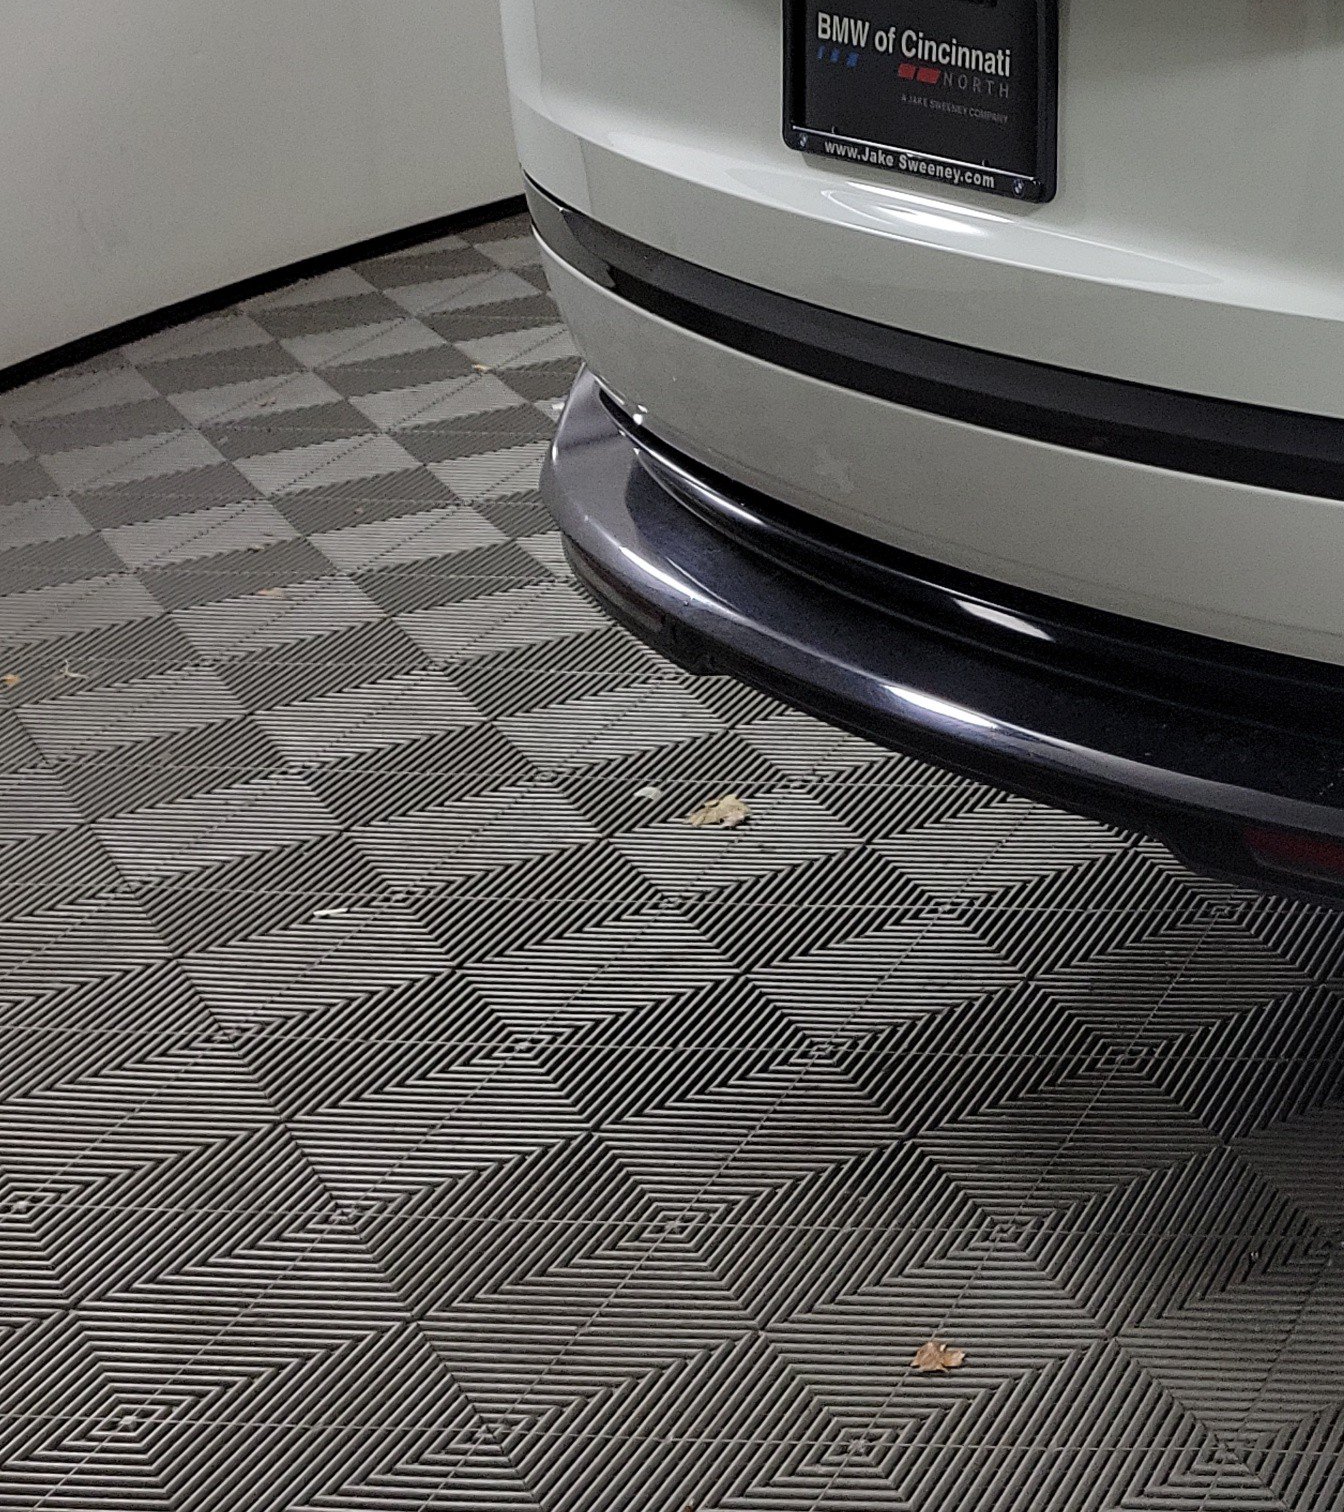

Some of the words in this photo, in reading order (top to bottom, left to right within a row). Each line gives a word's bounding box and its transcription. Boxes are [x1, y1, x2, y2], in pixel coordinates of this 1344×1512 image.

[817, 12, 870, 48] BMW
[875, 27, 896, 54] of
[901, 29, 1011, 77] Cincinnati
[943, 72, 1010, 99] NORTH
[824, 140, 894, 168] www.Jake
[899, 155, 995, 189] Sweeney.com
